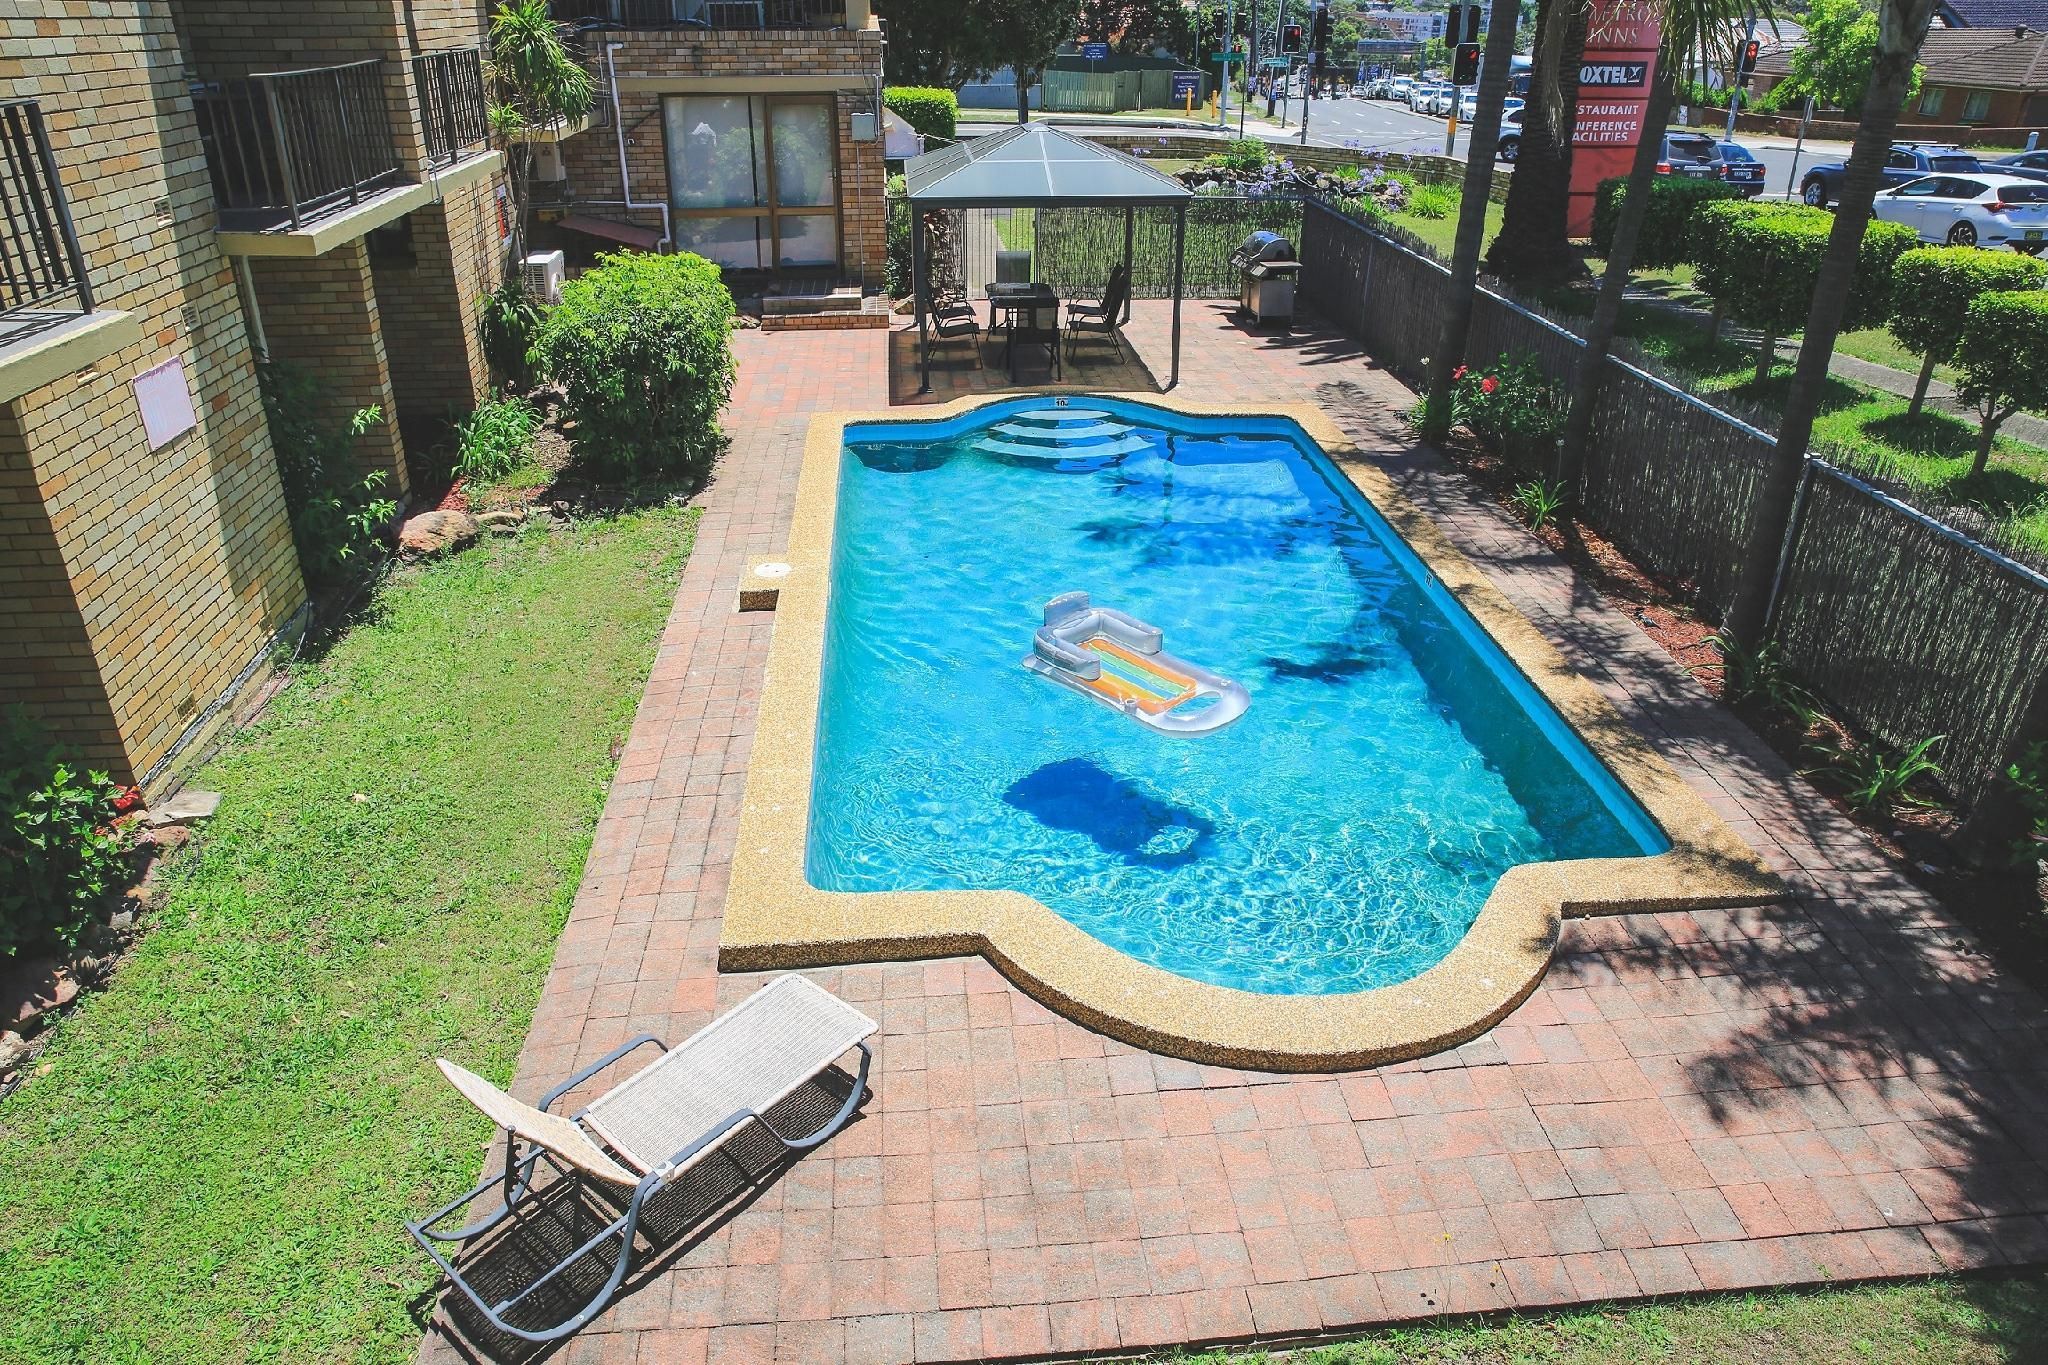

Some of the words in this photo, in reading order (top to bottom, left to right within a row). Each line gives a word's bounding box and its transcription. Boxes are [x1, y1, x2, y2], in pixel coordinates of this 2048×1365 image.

[1589, 28, 1638, 43] INNS
[1579, 66, 1628, 84] OXTEL
[1576, 105, 1639, 115] STAURANT
[1575, 121, 1637, 131] NFERENCE
[1571, 132, 1628, 142] ACILITIES
